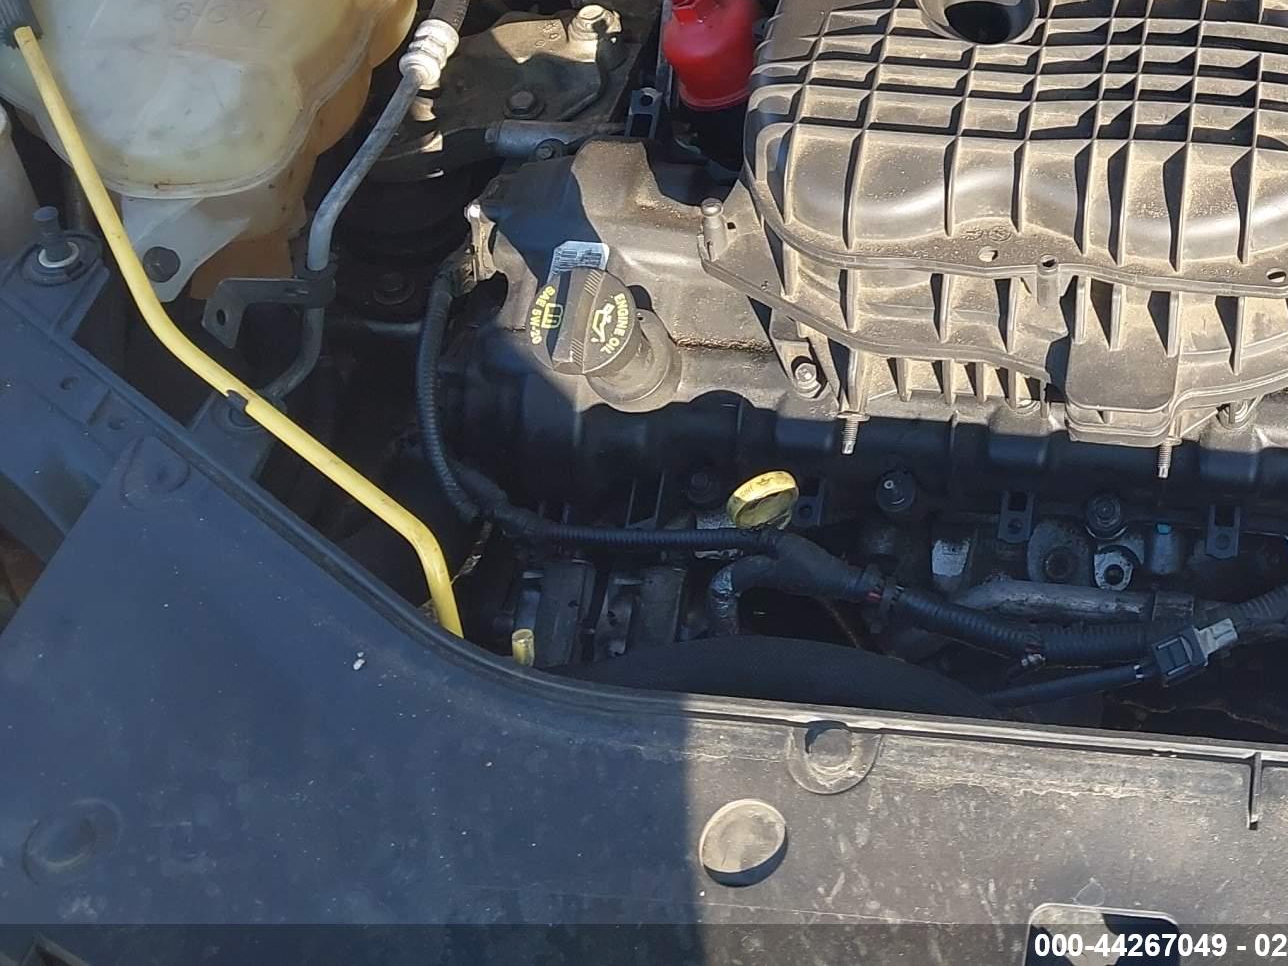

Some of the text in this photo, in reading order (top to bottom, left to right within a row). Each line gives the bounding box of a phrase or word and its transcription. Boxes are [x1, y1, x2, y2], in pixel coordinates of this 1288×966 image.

[529, 286, 556, 345] SAE 5W-20
[600, 292, 629, 355] ENGINE OIL
